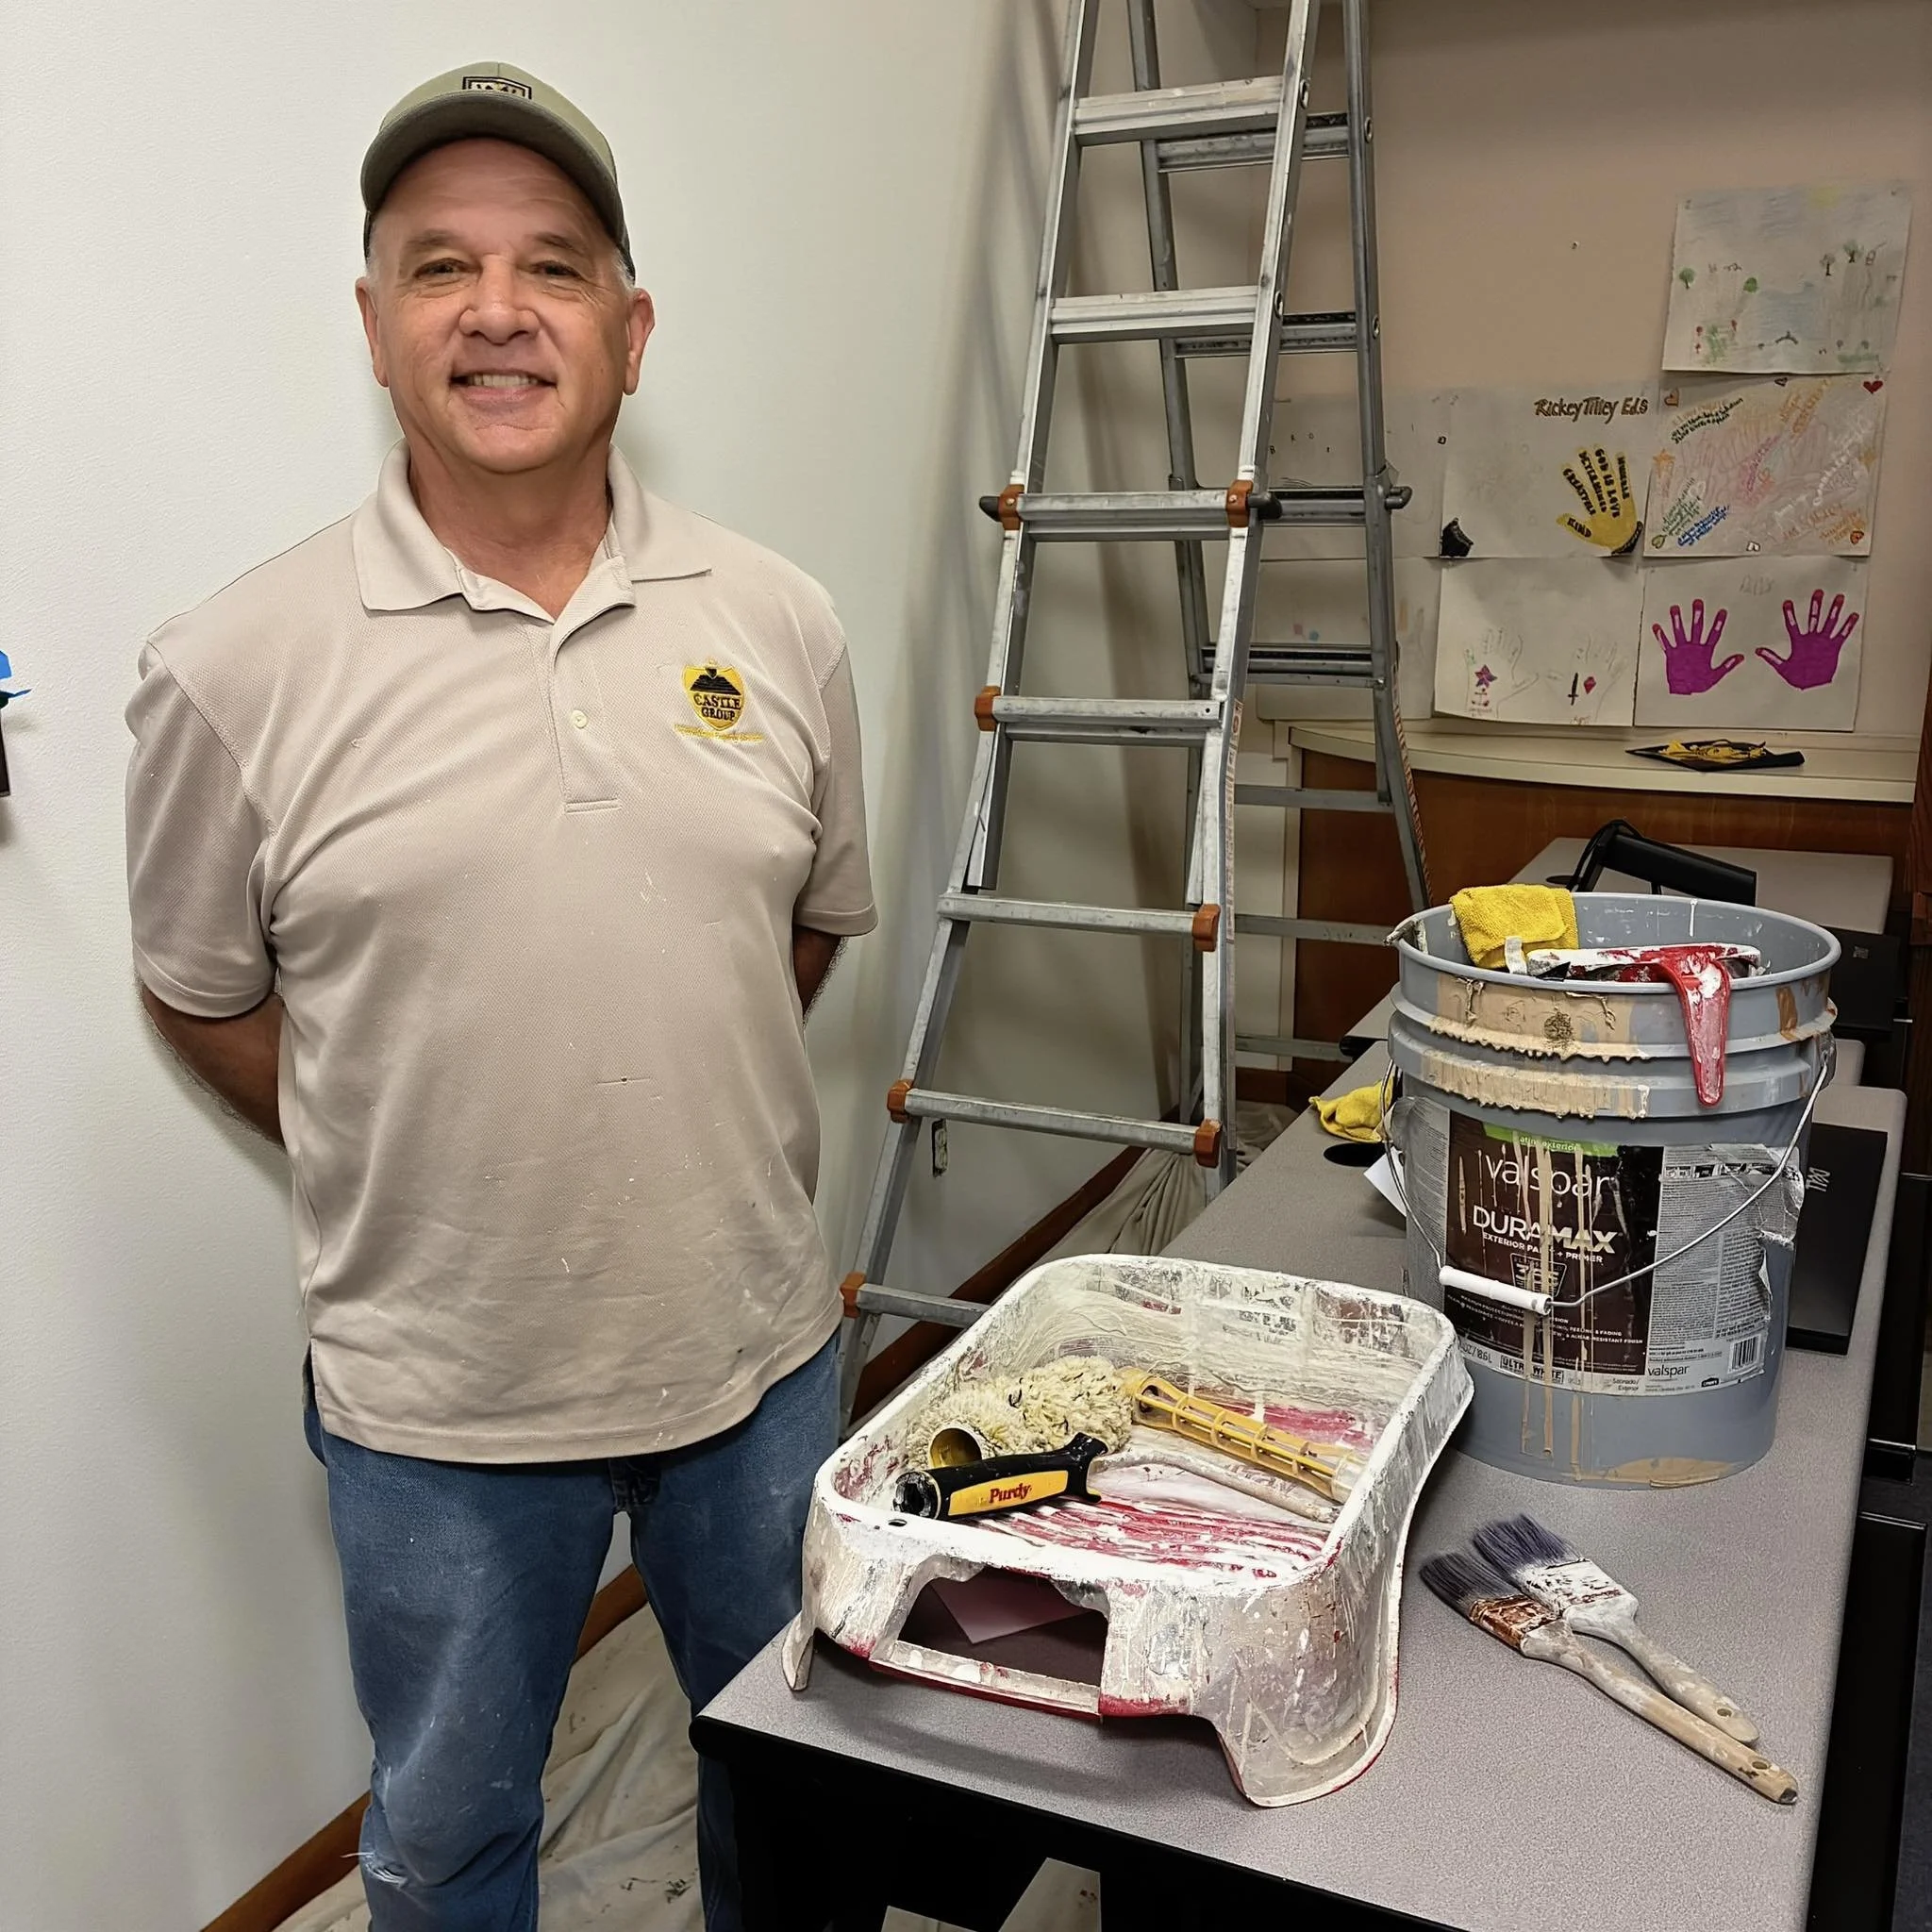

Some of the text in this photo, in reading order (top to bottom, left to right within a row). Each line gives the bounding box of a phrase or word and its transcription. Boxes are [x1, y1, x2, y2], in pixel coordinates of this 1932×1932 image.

[1594, 448, 1621, 519] GOD IS LOVE
[1567, 517, 1592, 538] KIND
[692, 692, 742, 710] CASTLE
[701, 707, 736, 722] GROUP
[1473, 1205, 1619, 1254] DURAMAX
[1482, 1231, 1525, 1251] EXTERIOR
[1502, 1357, 1562, 1380] ULTR WHTE
[1647, 1364, 1690, 1378] valspar
[989, 1482, 1032, 1504] Purdy
